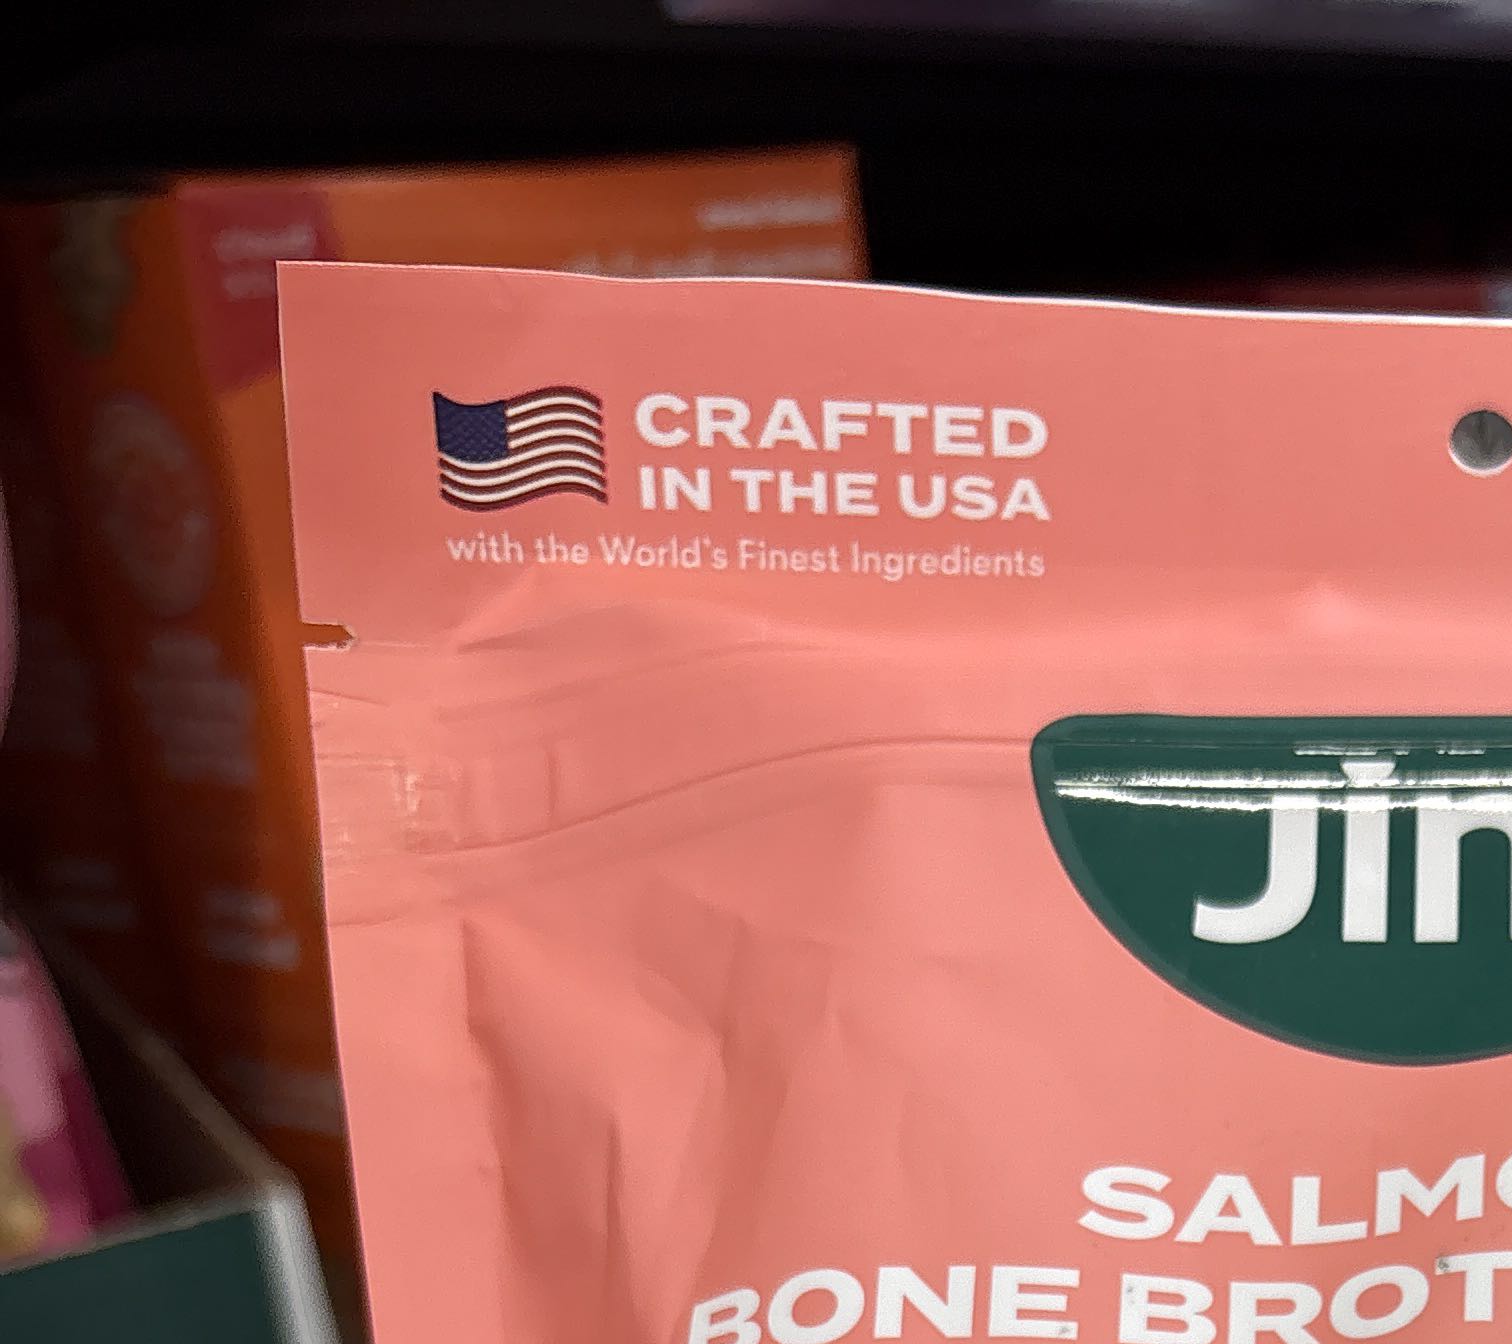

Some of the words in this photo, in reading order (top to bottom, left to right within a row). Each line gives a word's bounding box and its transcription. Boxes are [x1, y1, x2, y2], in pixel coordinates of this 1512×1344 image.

[634, 393, 1049, 460] CRAFTED
[638, 465, 712, 513] IN
[730, 468, 880, 517] THE
[901, 473, 1052, 522] USA
[447, 531, 525, 565] with
[535, 533, 590, 566] the
[598, 534, 729, 572] World's
[738, 538, 841, 575] Finest
[851, 540, 1047, 583] Ingredients
